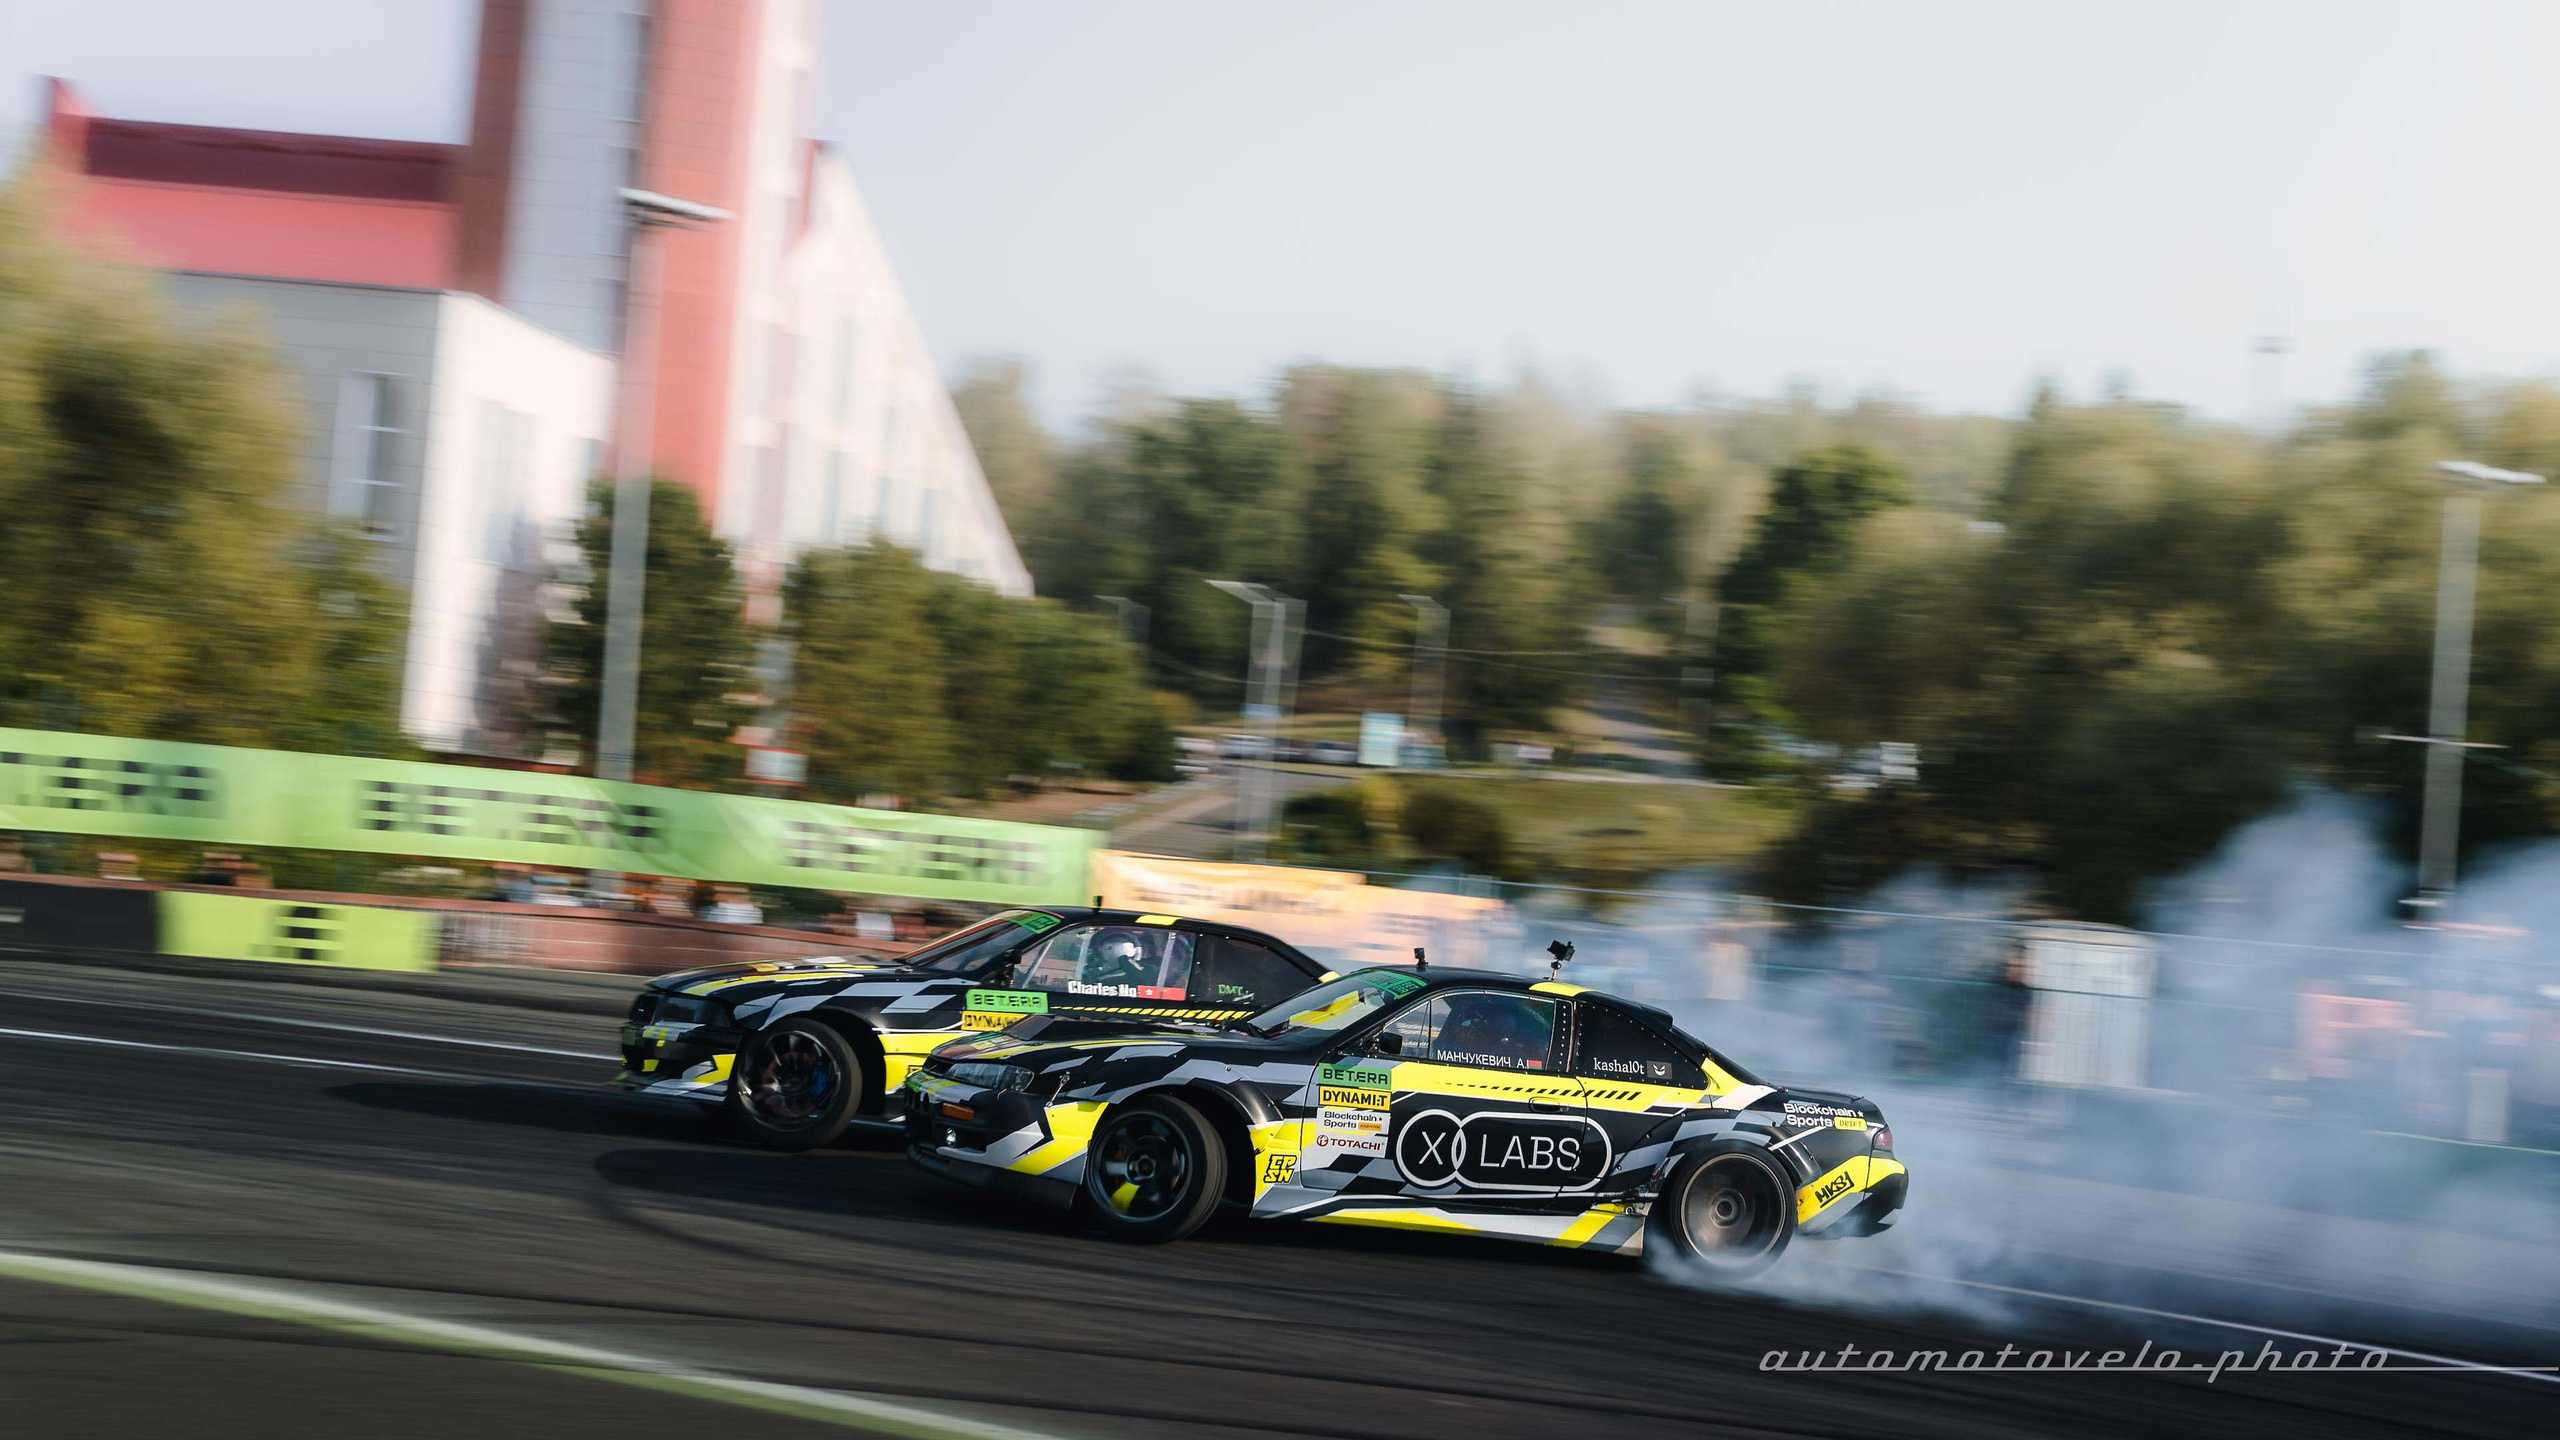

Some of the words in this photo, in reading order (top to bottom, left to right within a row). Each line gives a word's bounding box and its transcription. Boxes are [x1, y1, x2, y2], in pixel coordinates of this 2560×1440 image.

[1068, 980, 1117, 996] Charles
[1118, 984, 1137, 998] Ng
[1437, 1049, 1511, 1068] МАНЧУКЕВИЧ
[1324, 1111, 1377, 1123] Blockchain
[1783, 1103, 1857, 1118] Blockchain
[1323, 1119, 1357, 1129] Sports
[1786, 1114, 1832, 1128] Sports
[1839, 1119, 1862, 1128] DRIFT
[1330, 1138, 1381, 1151] TOTACHI
[1418, 1131, 1447, 1165] X
[1480, 1133, 1580, 1171] LABS
